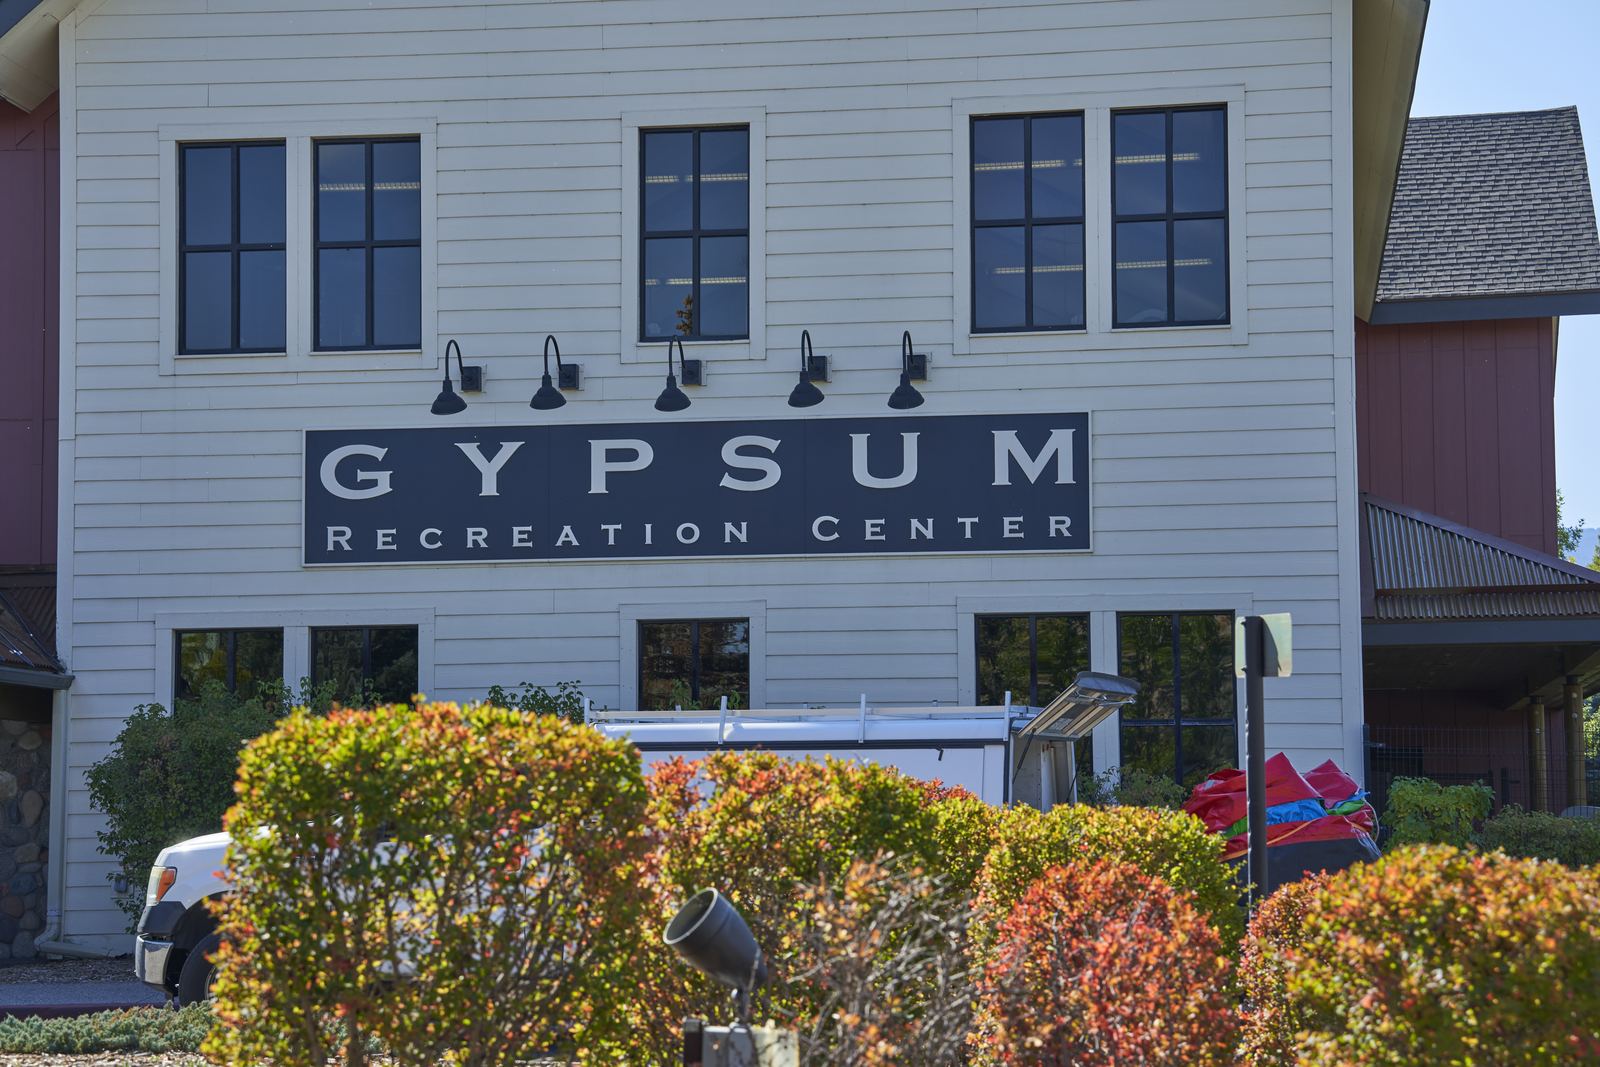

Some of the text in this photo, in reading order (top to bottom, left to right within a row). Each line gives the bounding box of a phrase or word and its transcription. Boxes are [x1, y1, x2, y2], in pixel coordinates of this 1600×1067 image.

[319, 428, 1077, 500] GYPSUM
[325, 514, 1073, 553] RECREATION CENTER
